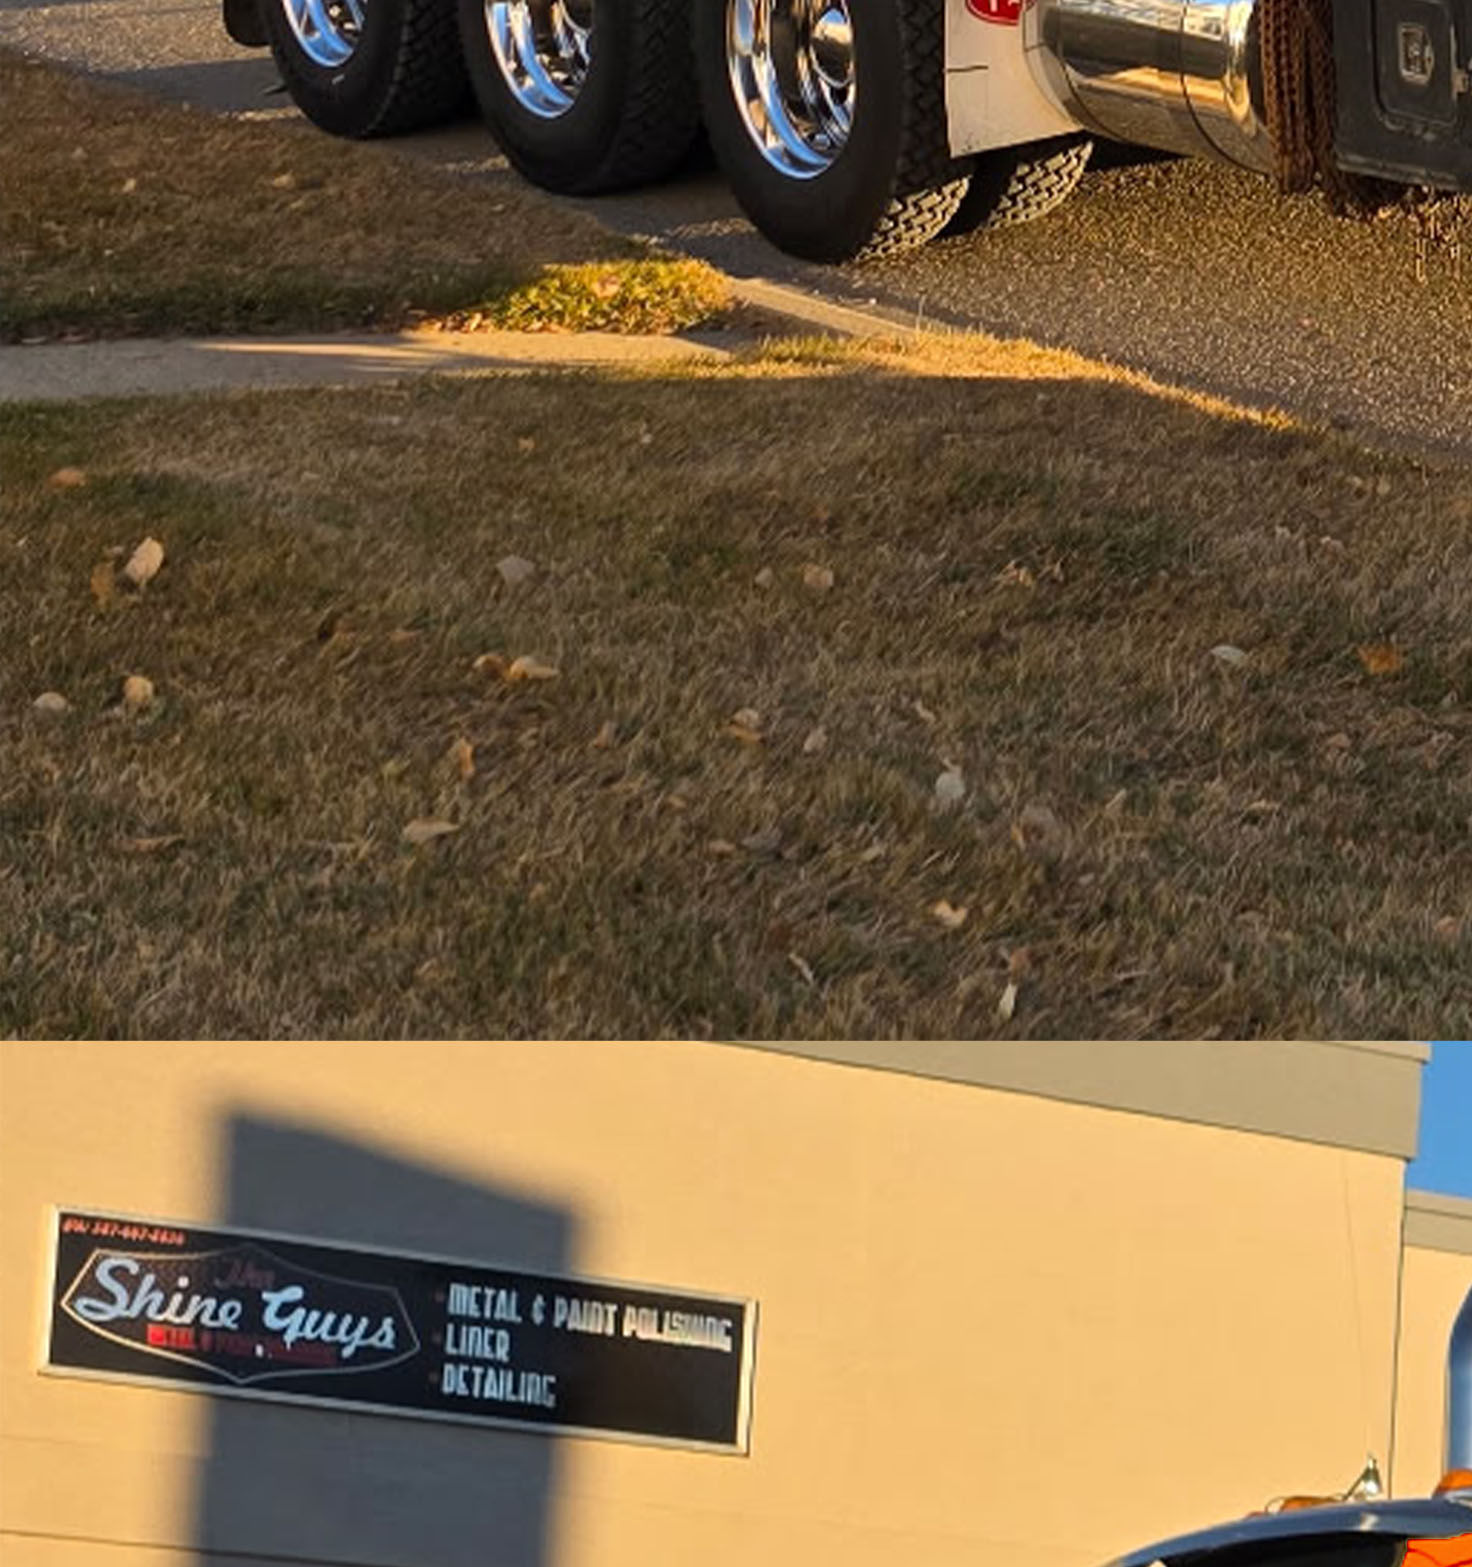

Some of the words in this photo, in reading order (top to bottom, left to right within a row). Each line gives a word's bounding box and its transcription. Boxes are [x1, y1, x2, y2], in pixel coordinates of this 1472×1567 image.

[73, 1257, 243, 1331] Shine
[261, 1285, 396, 1360] Guys
[448, 1283, 523, 1323] METAL
[553, 1294, 618, 1337] PAINT
[445, 1323, 510, 1363] LINER
[441, 1363, 557, 1408] DETAILING
